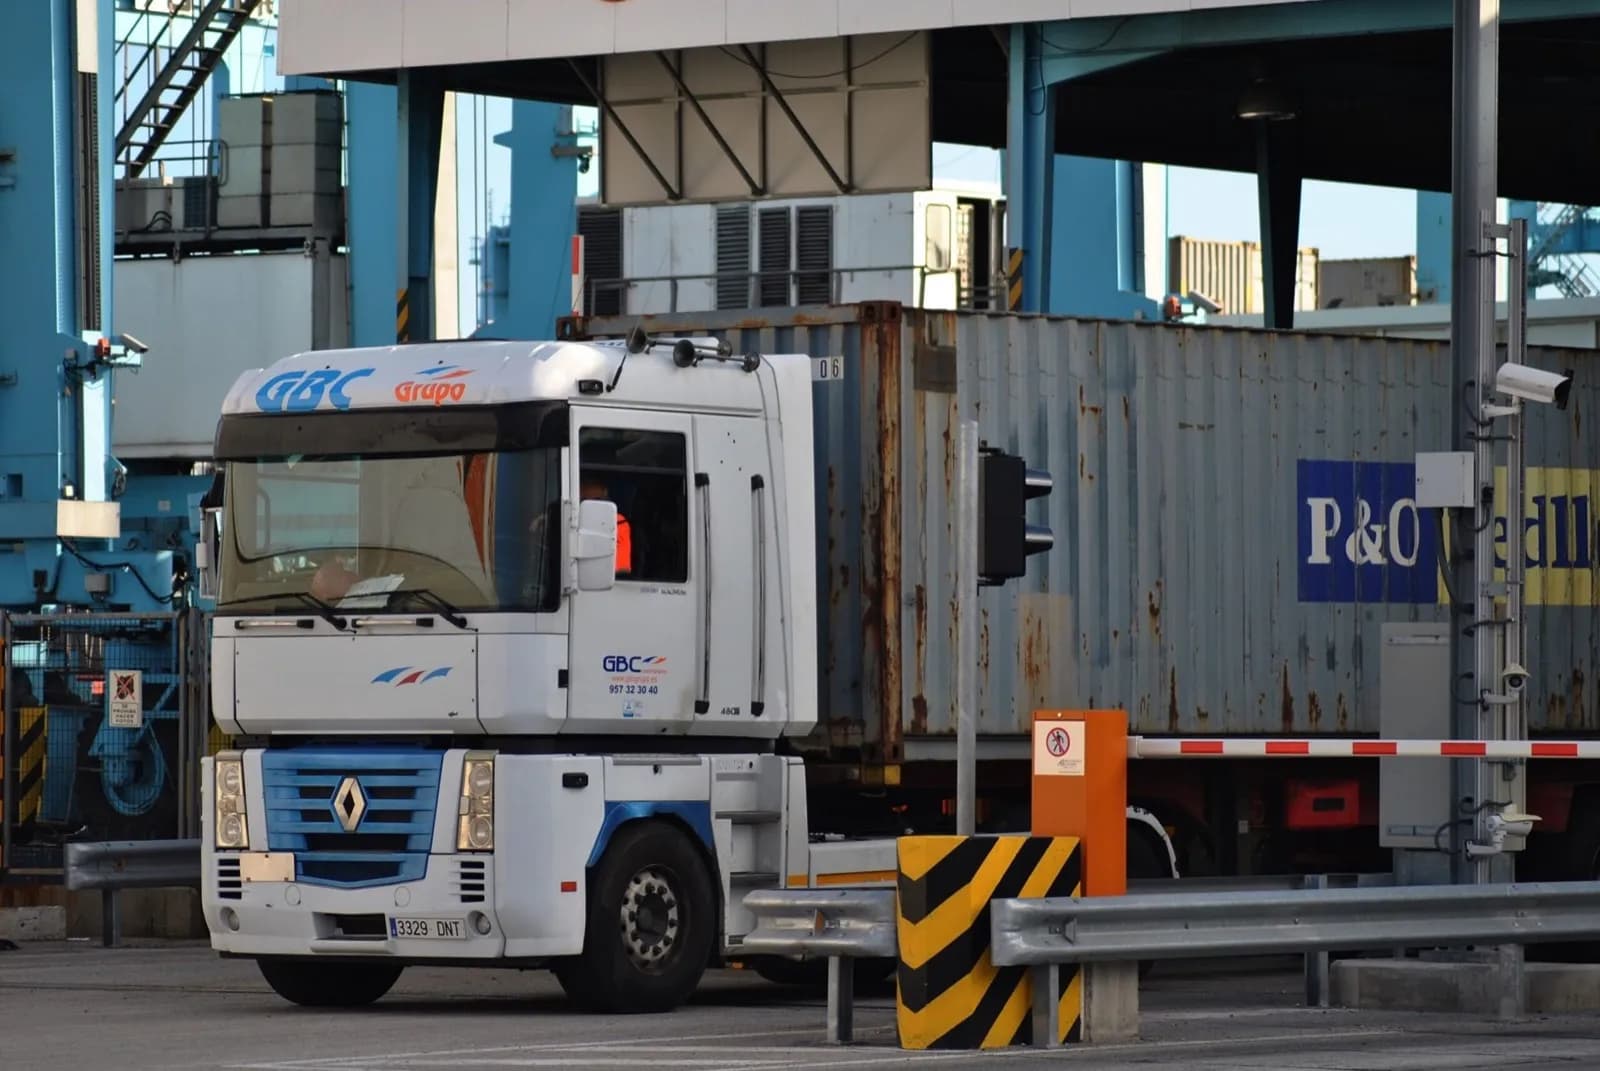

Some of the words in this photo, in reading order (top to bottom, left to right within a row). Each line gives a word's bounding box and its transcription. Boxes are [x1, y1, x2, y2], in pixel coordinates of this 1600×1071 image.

[255, 368, 377, 412] GBC
[394, 381, 466, 407] Grupo
[1306, 497, 1421, 567] P&O
[603, 655, 642, 673] GBC
[609, 684, 624, 694] 957
[625, 685, 636, 694] 32
[637, 685, 647, 694] 30
[648, 685, 658, 694] 40
[397, 920, 429, 936] 3329
[436, 920, 460, 937] DNT
